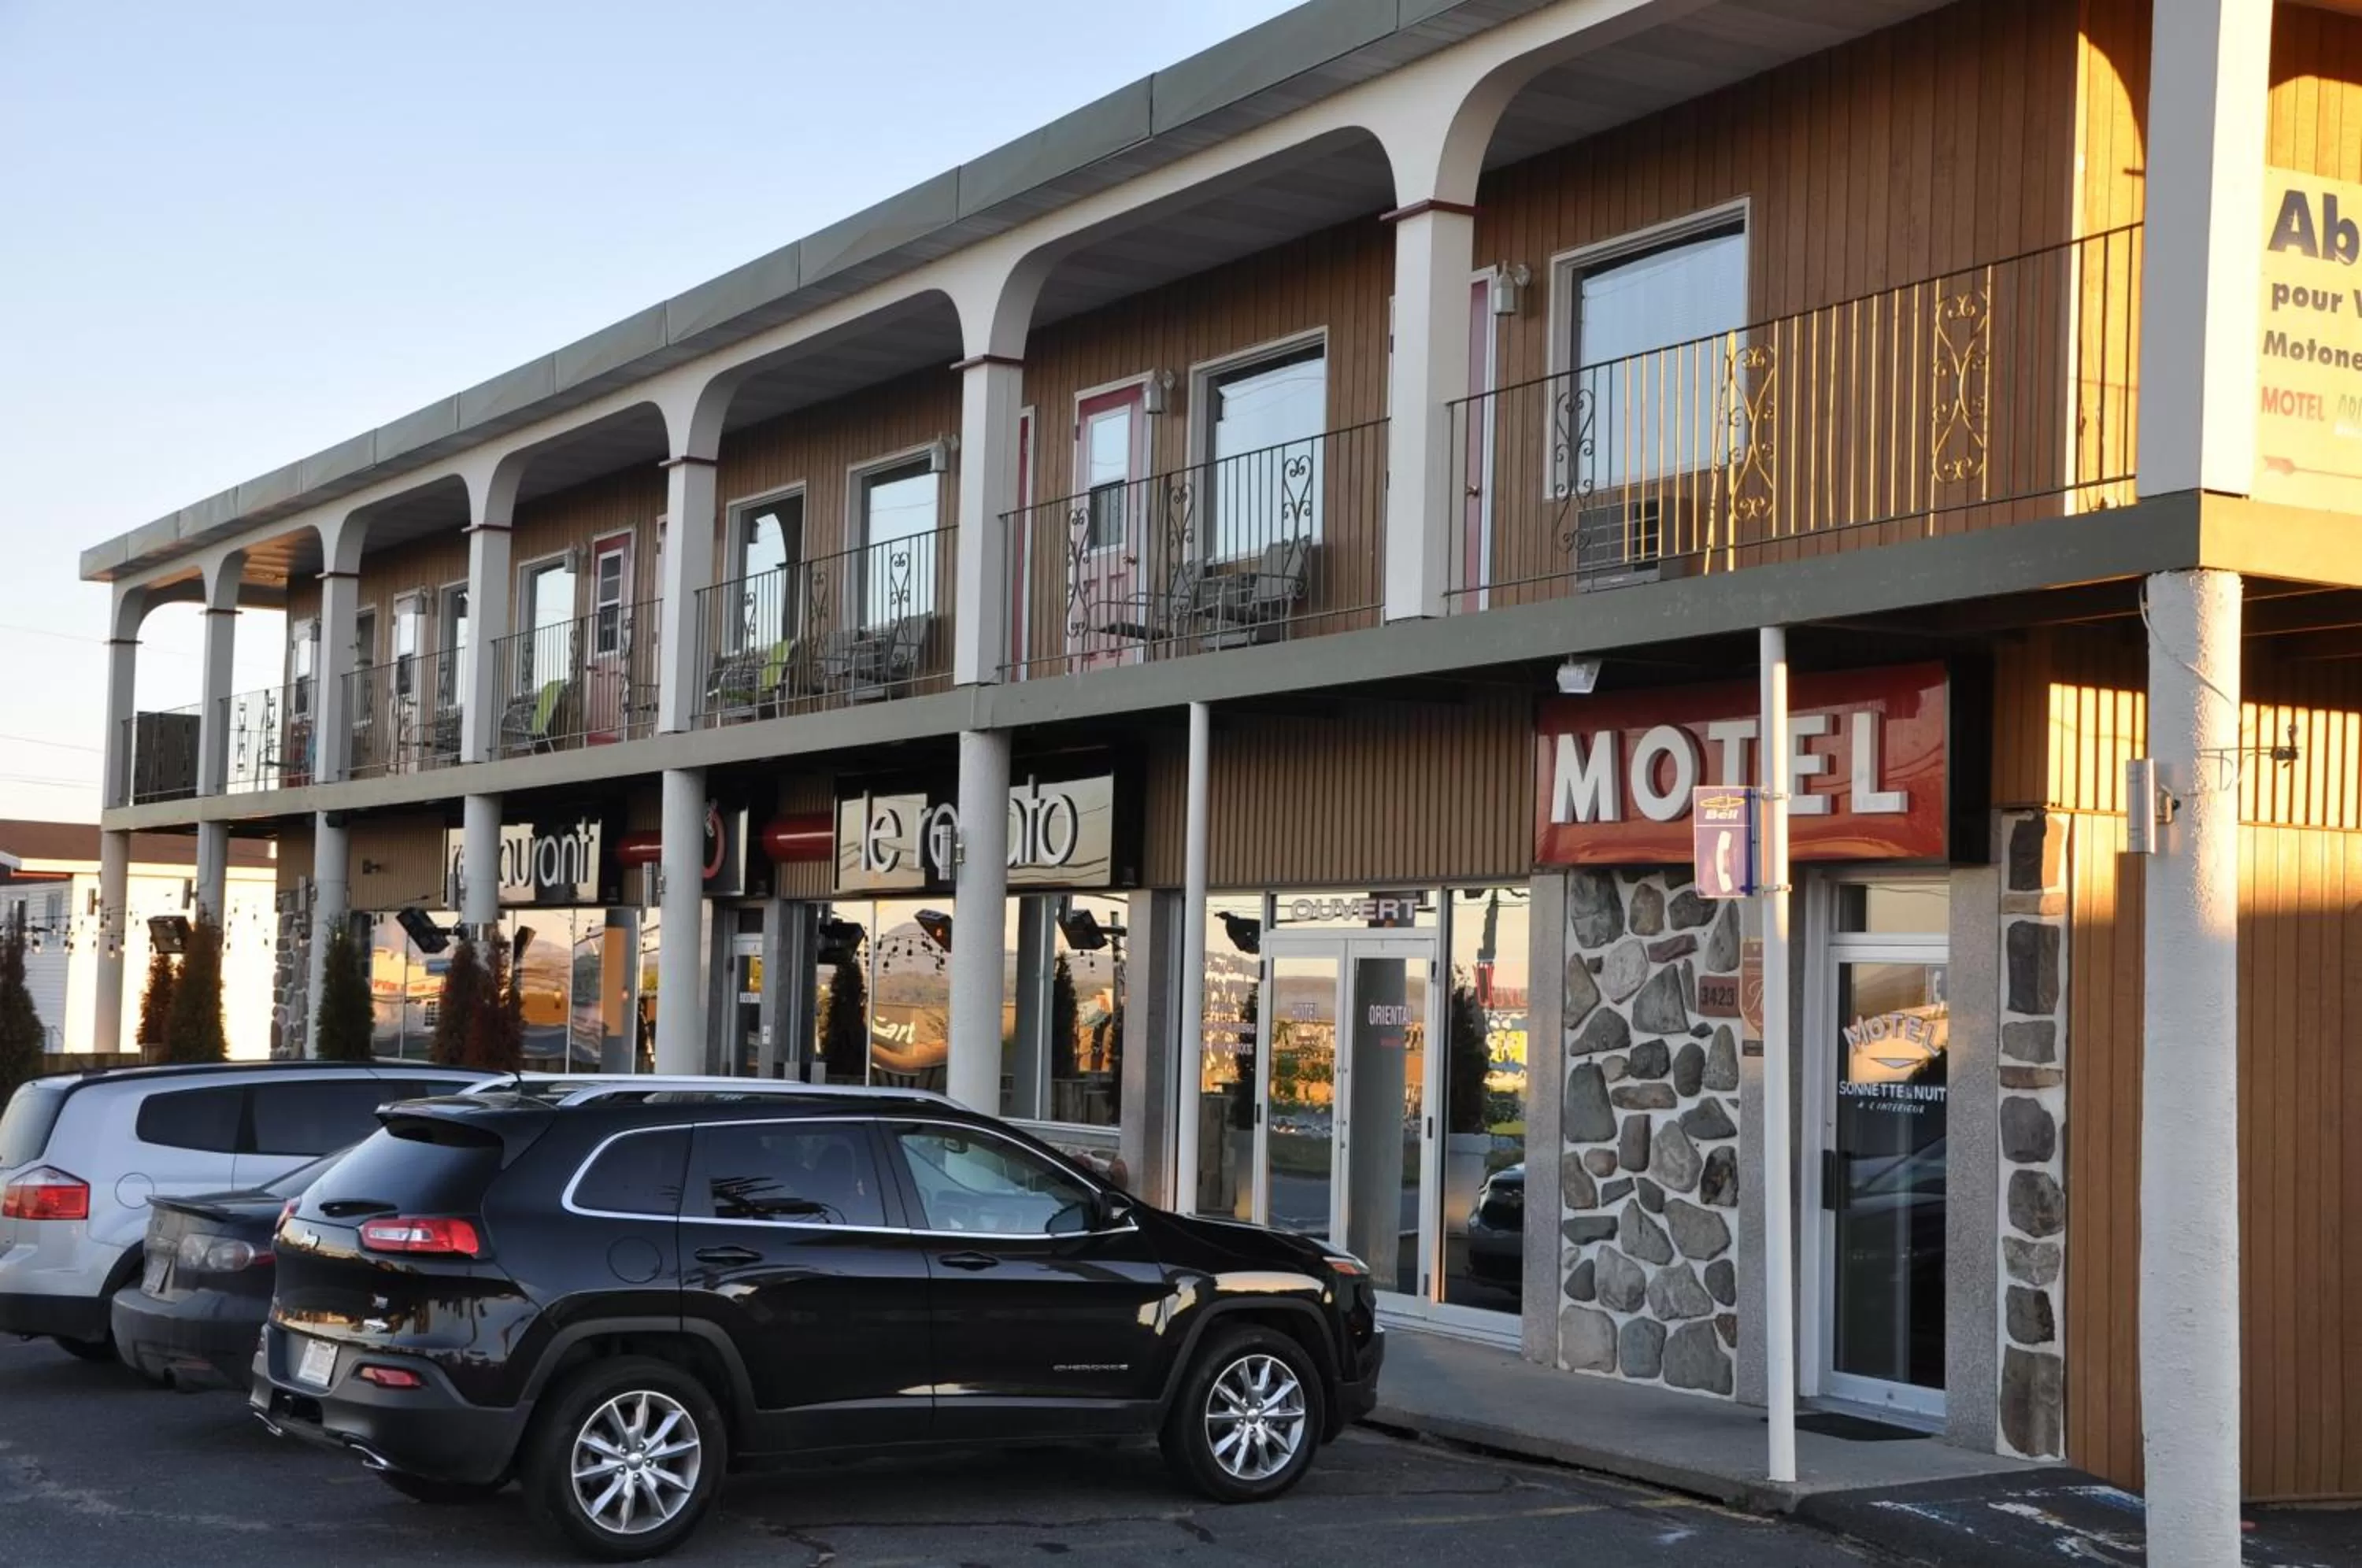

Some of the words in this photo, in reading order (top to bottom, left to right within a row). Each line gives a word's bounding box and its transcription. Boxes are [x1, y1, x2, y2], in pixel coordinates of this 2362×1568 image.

[2271, 282, 2344, 313] pour
[2260, 385, 2325, 422] MOTEL
[1550, 712, 1908, 823] MOTEL
[861, 790, 902, 874] le
[1290, 897, 1421, 922] OUVERT
[1368, 1004, 1413, 1026] ORIENTAL
[1842, 1012, 1941, 1057] MOTEL
[1838, 1081, 1904, 1099] SONNETTE
[1914, 1085, 1946, 1102] NUIT
